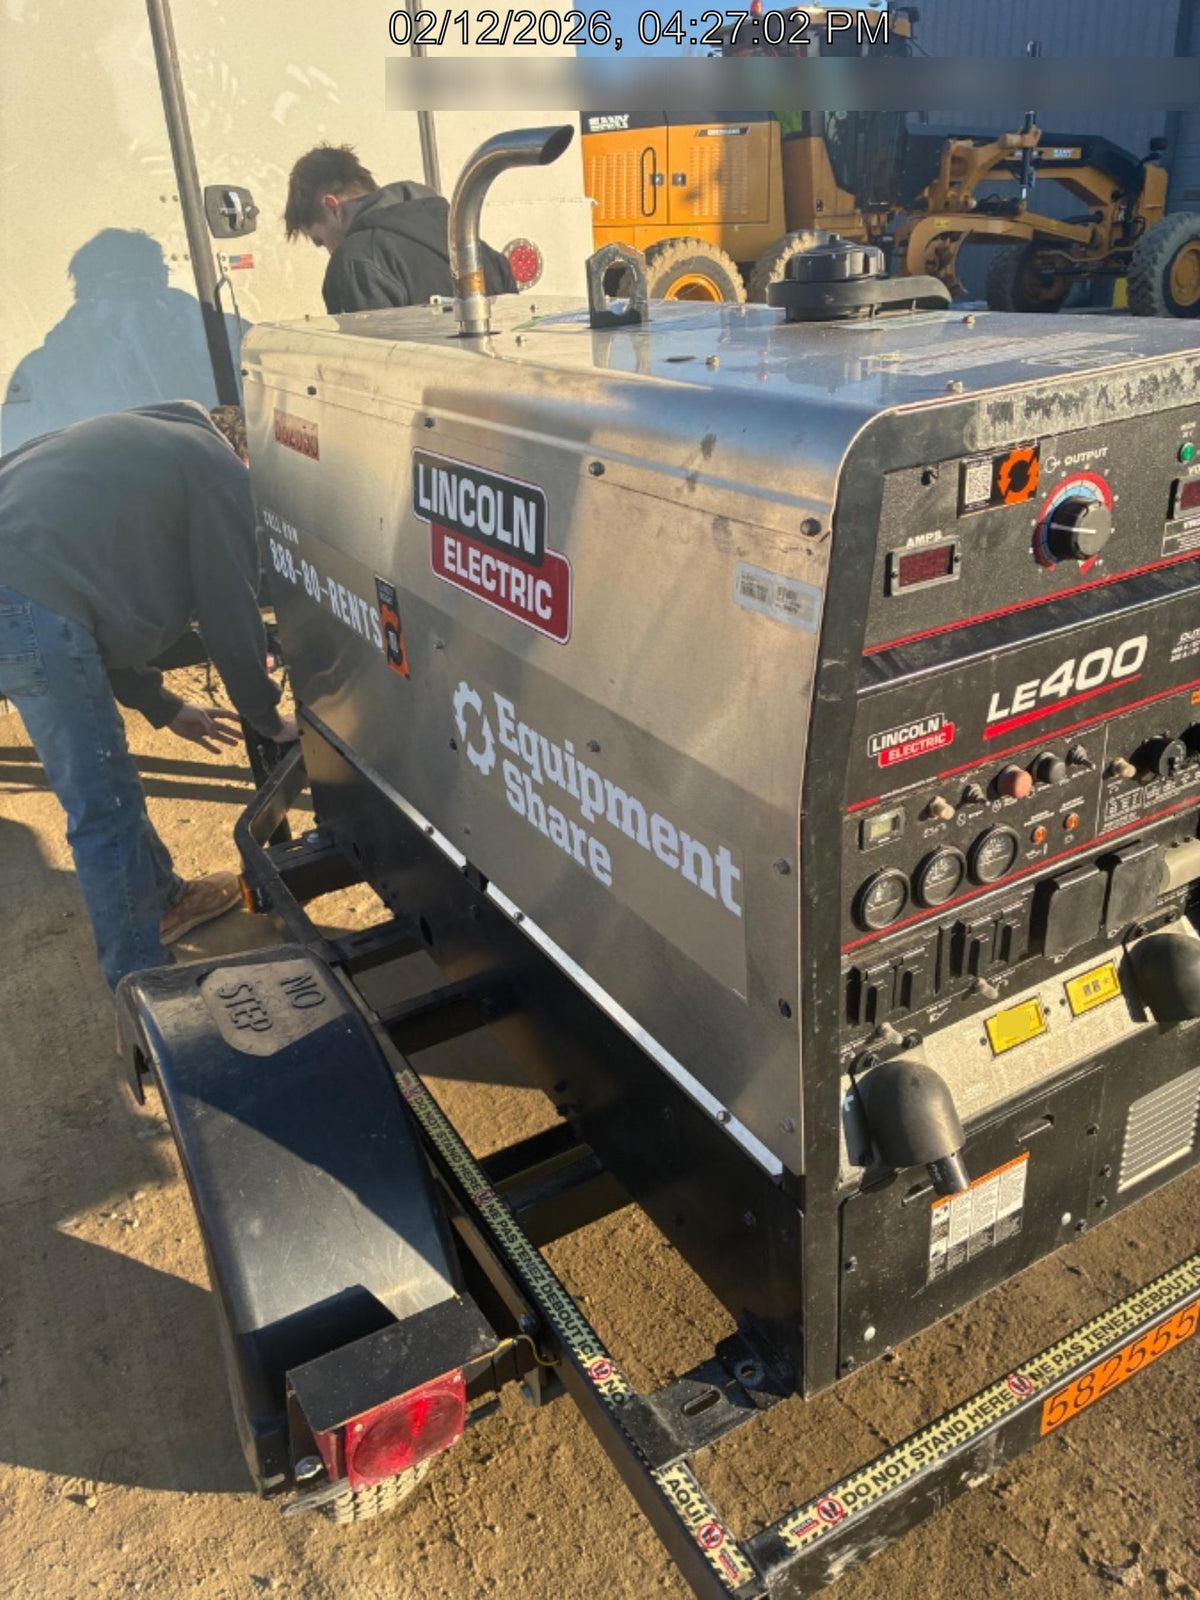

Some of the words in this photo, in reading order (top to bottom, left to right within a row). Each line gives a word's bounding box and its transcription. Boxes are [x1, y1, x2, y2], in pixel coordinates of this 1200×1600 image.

[1064, 447, 1109, 466] OUTPUT
[418, 463, 537, 556] LINCOLN
[906, 530, 942, 549] AMPS
[269, 538, 386, 654] 888-80-RENTS
[443, 536, 553, 620] ELECTRIC
[987, 634, 1148, 723] LE400
[872, 717, 940, 752] LINCOLN
[888, 732, 946, 761] ELECTRIC
[493, 691, 742, 918] Equipment
[502, 758, 613, 888] Share
[218, 984, 273, 1031] STEP
[280, 974, 327, 1009] NO
[499, 1219, 517, 1244] PAS
[517, 1247, 545, 1282] TENEZ
[540, 1284, 584, 1338] DEBOUT
[603, 1379, 625, 1404] NO
[841, 1482, 871, 1507] DO
[871, 1455, 910, 1487] NOT
[909, 1419, 968, 1461] STAND
[967, 1390, 1014, 1424] HERE
[1030, 1363, 1054, 1382] NE
[1053, 1342, 1086, 1366] PAS
[1081, 1312, 1131, 1346] TENEZ
[1129, 1273, 1190, 1315] DEBOUT
[1046, 1302, 1198, 1427] 582555
[666, 1479, 705, 1524] AQUI
